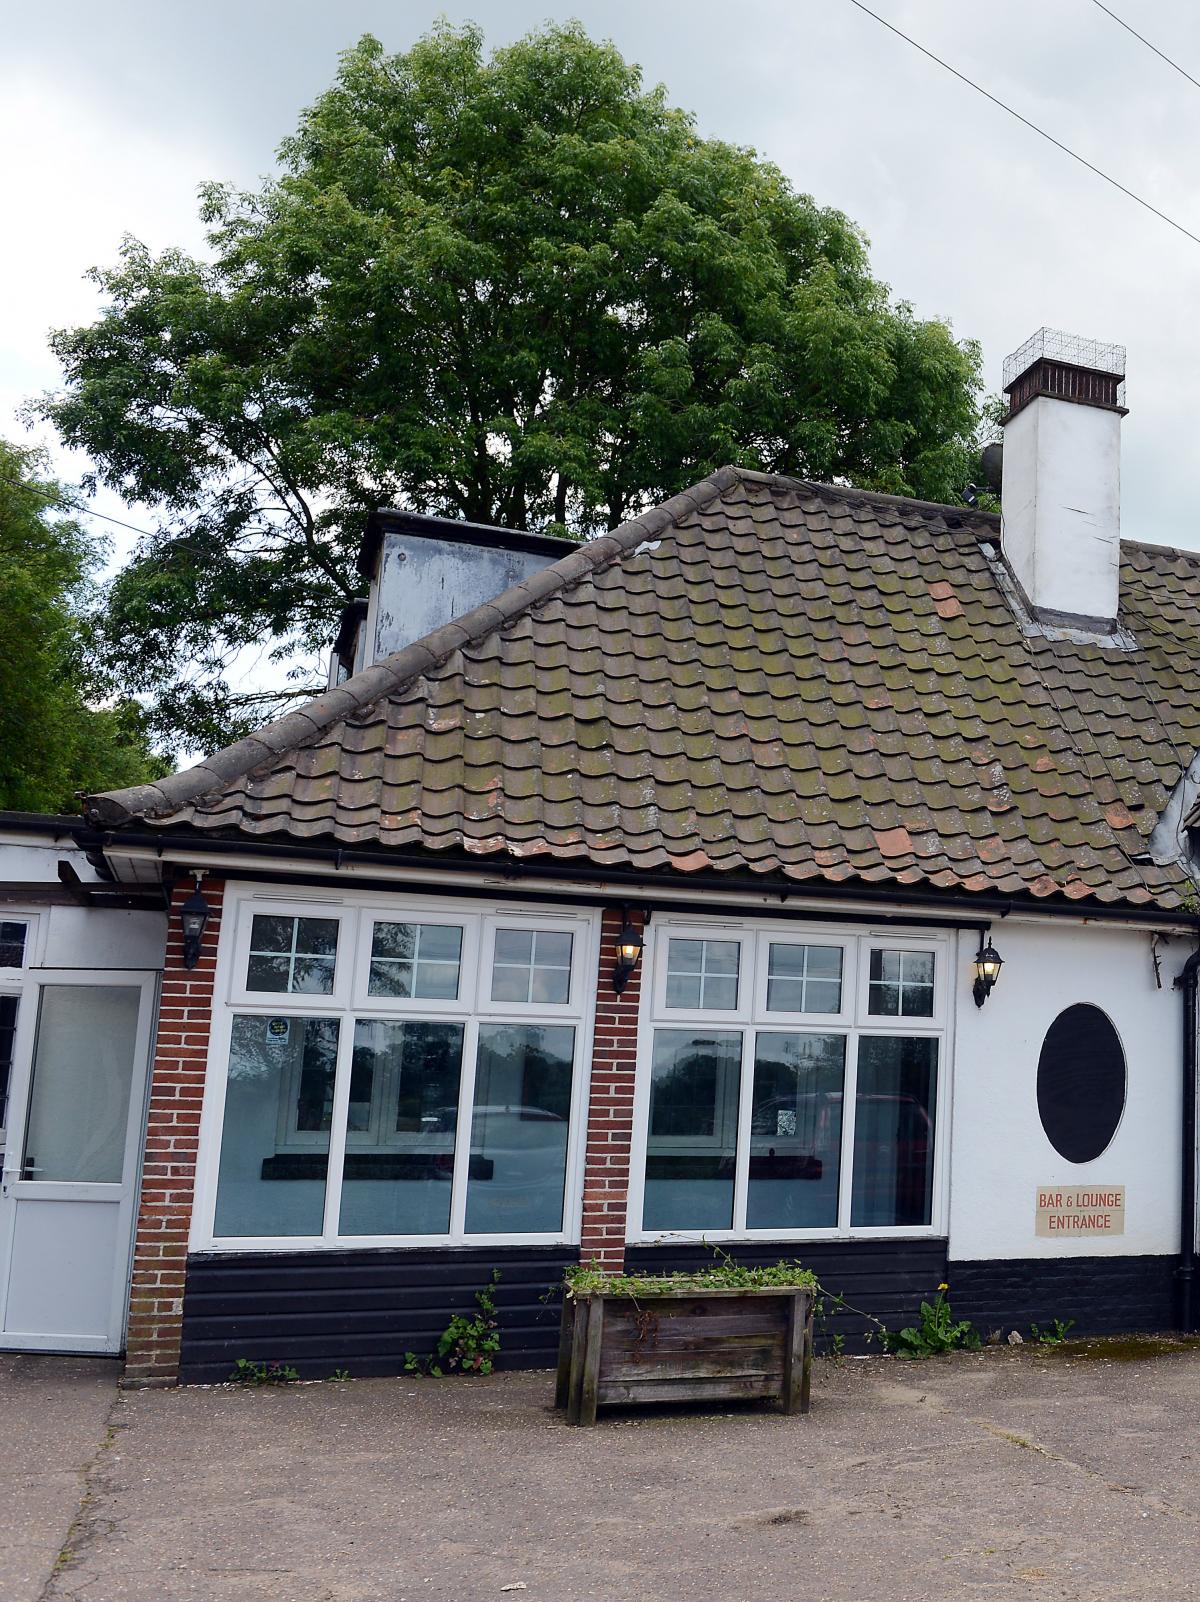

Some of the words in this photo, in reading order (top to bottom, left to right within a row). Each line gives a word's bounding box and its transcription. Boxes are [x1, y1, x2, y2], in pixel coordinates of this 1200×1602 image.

[1040, 1193, 1063, 1208] BAR
[1066, 1195, 1073, 1208] &
[1076, 1193, 1122, 1207] LOUNGE
[1048, 1214, 1111, 1229] ENTRANCE
